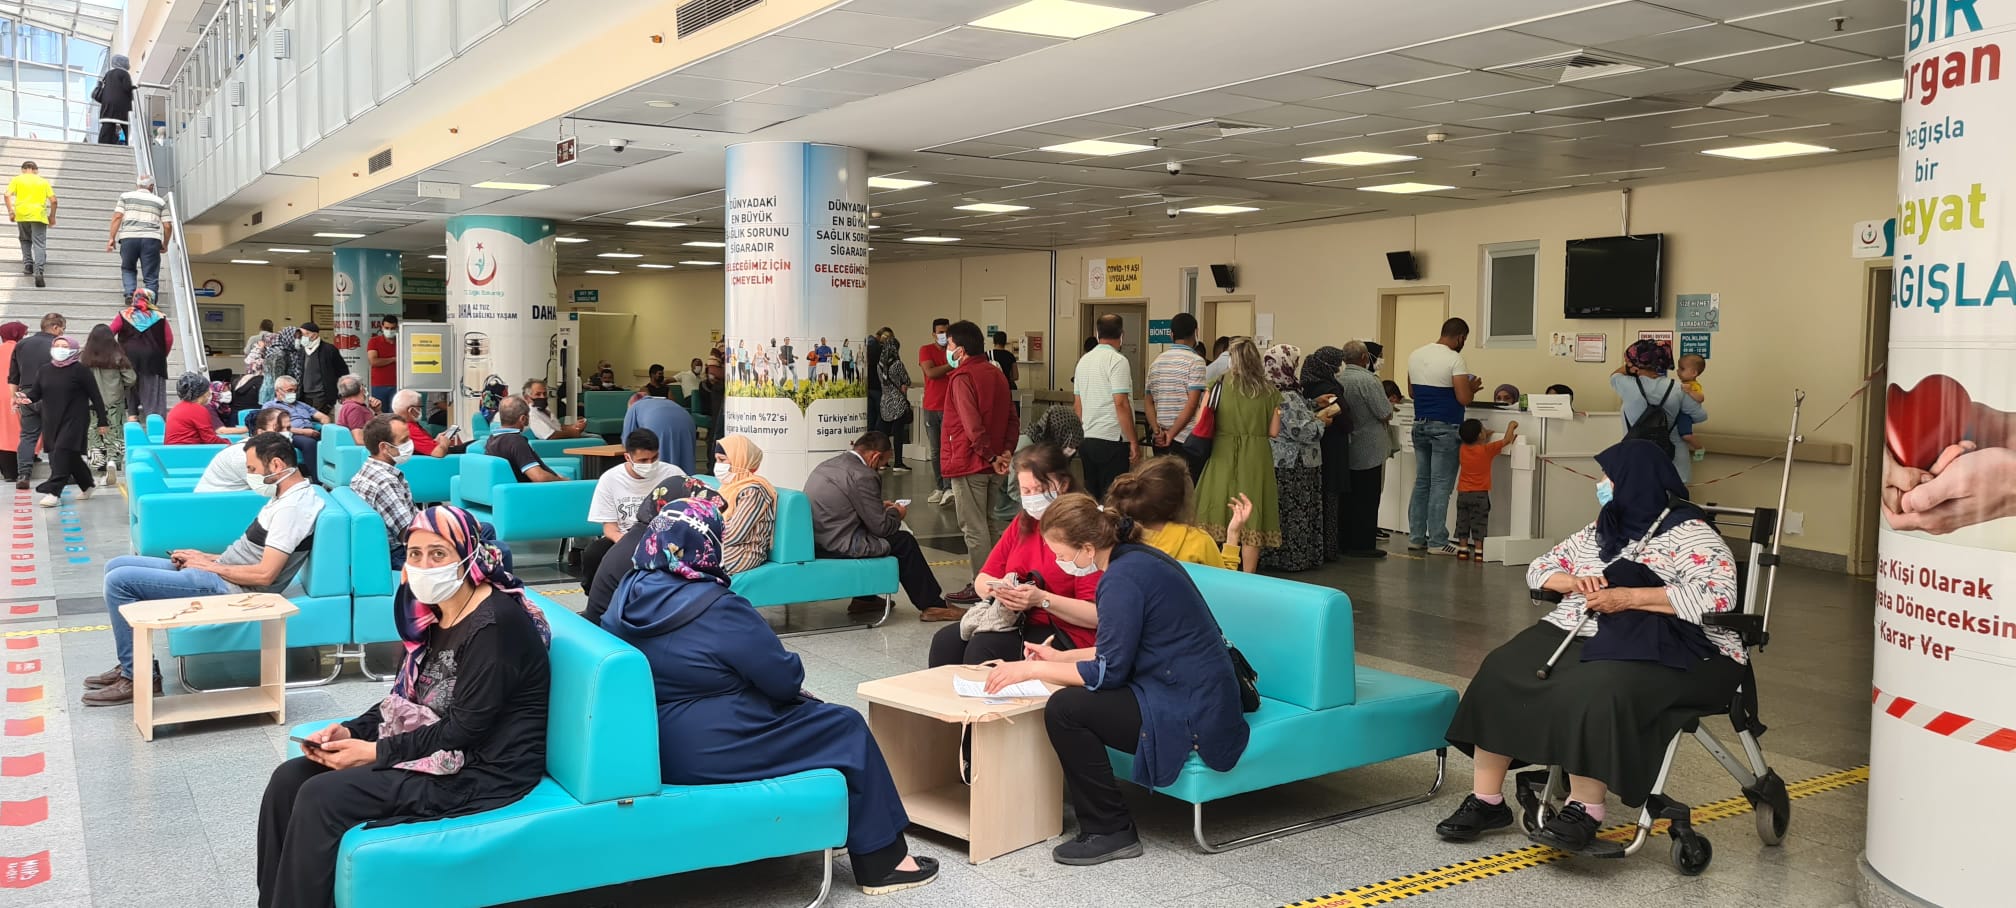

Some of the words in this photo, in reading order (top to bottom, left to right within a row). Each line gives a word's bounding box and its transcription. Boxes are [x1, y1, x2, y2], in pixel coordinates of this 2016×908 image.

[1906, 116, 1965, 150] bağışla
[1914, 158, 1939, 182] bir
[731, 214, 740, 224] EN
[741, 210, 773, 223] BÜYÜK
[832, 216, 845, 226] EN
[747, 227, 790, 237] SORUNU
[816, 228, 852, 242] SAĞLIK
[730, 242, 774, 254] SİGARADIR
[769, 258, 791, 271] İÇİN
[1109, 274, 1137, 282] UYGULAMA
[1115, 284, 1131, 292] ALANI
[496, 312, 518, 320] YAŞAM
[816, 426, 842, 437] sigara
[1877, 553, 1888, 578] aç
[1889, 558, 1915, 586] Kişi
[1919, 567, 1994, 600] Olarak
[1880, 620, 1916, 650] Karar
[1920, 634, 1956, 661] Ver
[1391, 875, 1444, 891] BEKLEME
[1357, 888, 1393, 900] ALANI
